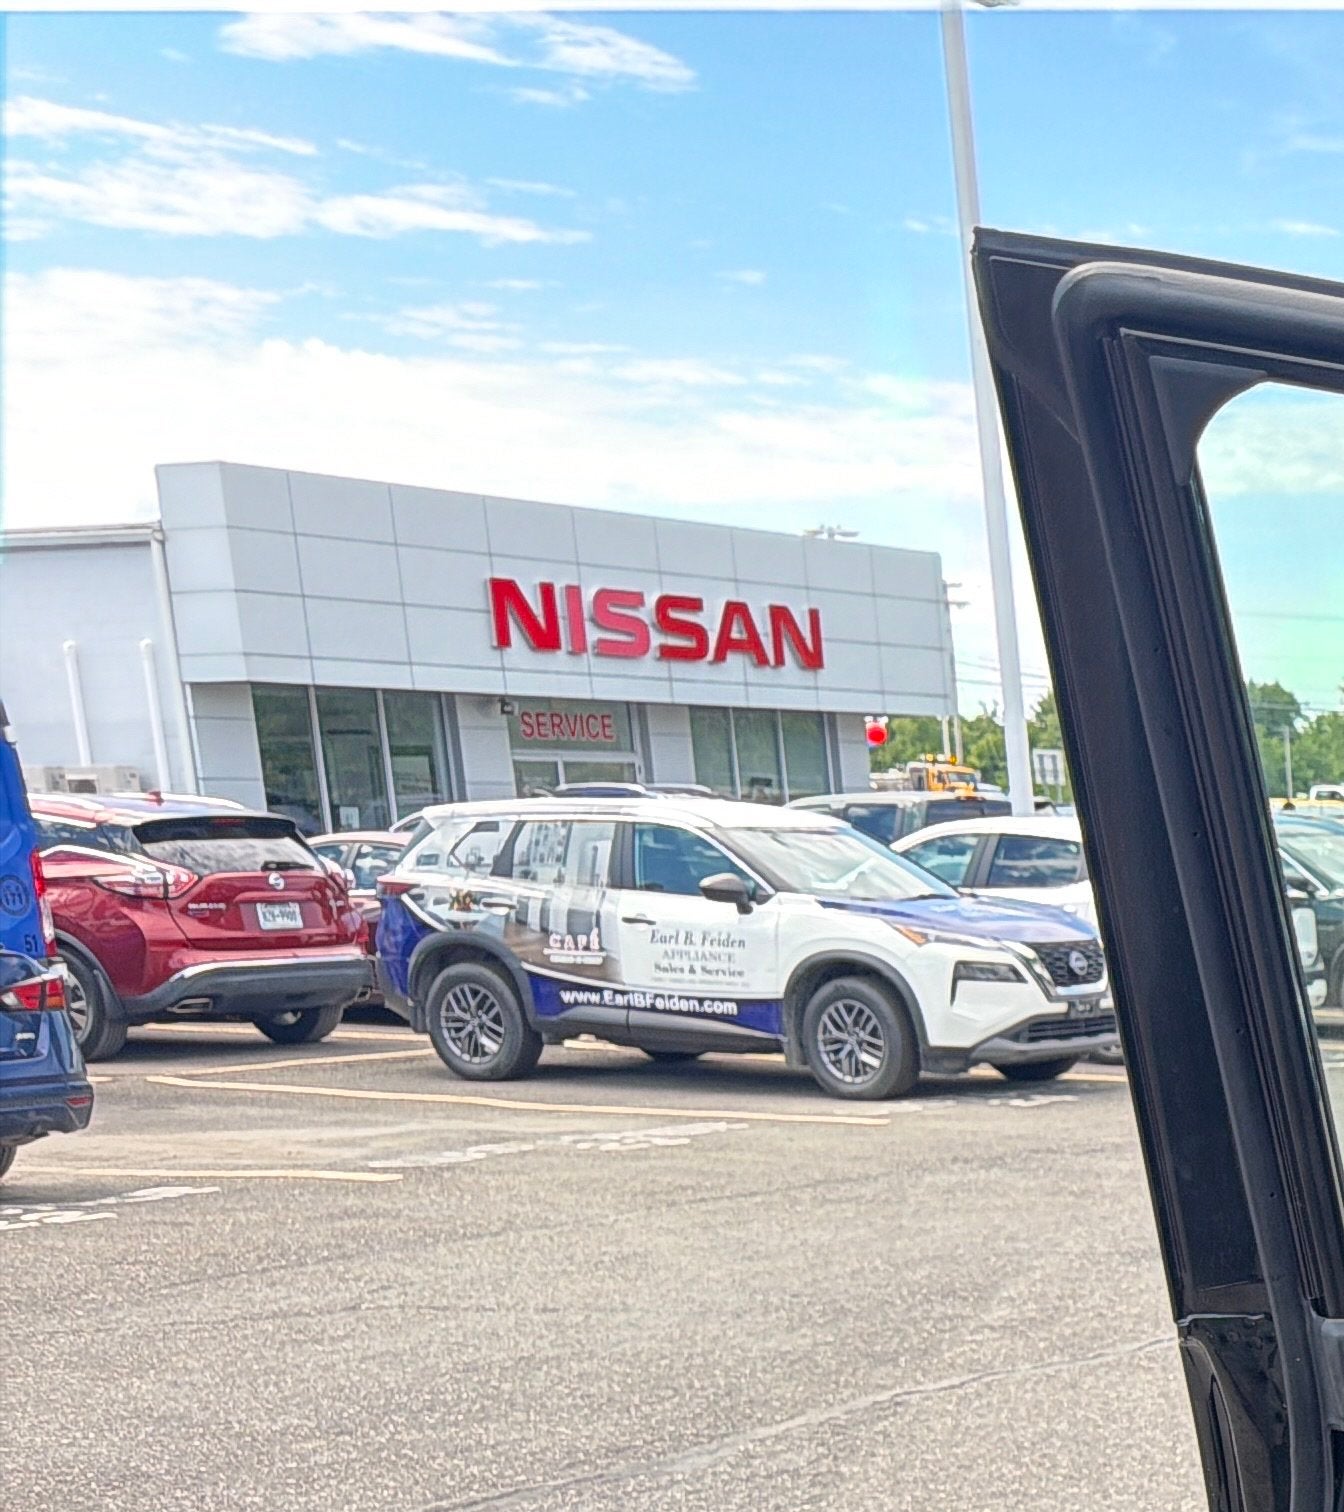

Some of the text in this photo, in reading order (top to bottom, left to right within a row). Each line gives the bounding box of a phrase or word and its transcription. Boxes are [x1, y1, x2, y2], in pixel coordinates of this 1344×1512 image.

[488, 577, 825, 670] NISSAN
[521, 710, 616, 740] SERVICE
[24, 934, 38, 953] 51
[650, 929, 680, 945] Earl
[701, 930, 746, 948] Feiden
[662, 949, 736, 963] APPLIANCE
[700, 964, 745, 977] Service
[560, 989, 738, 1016] www.EarlBFeiden.com
